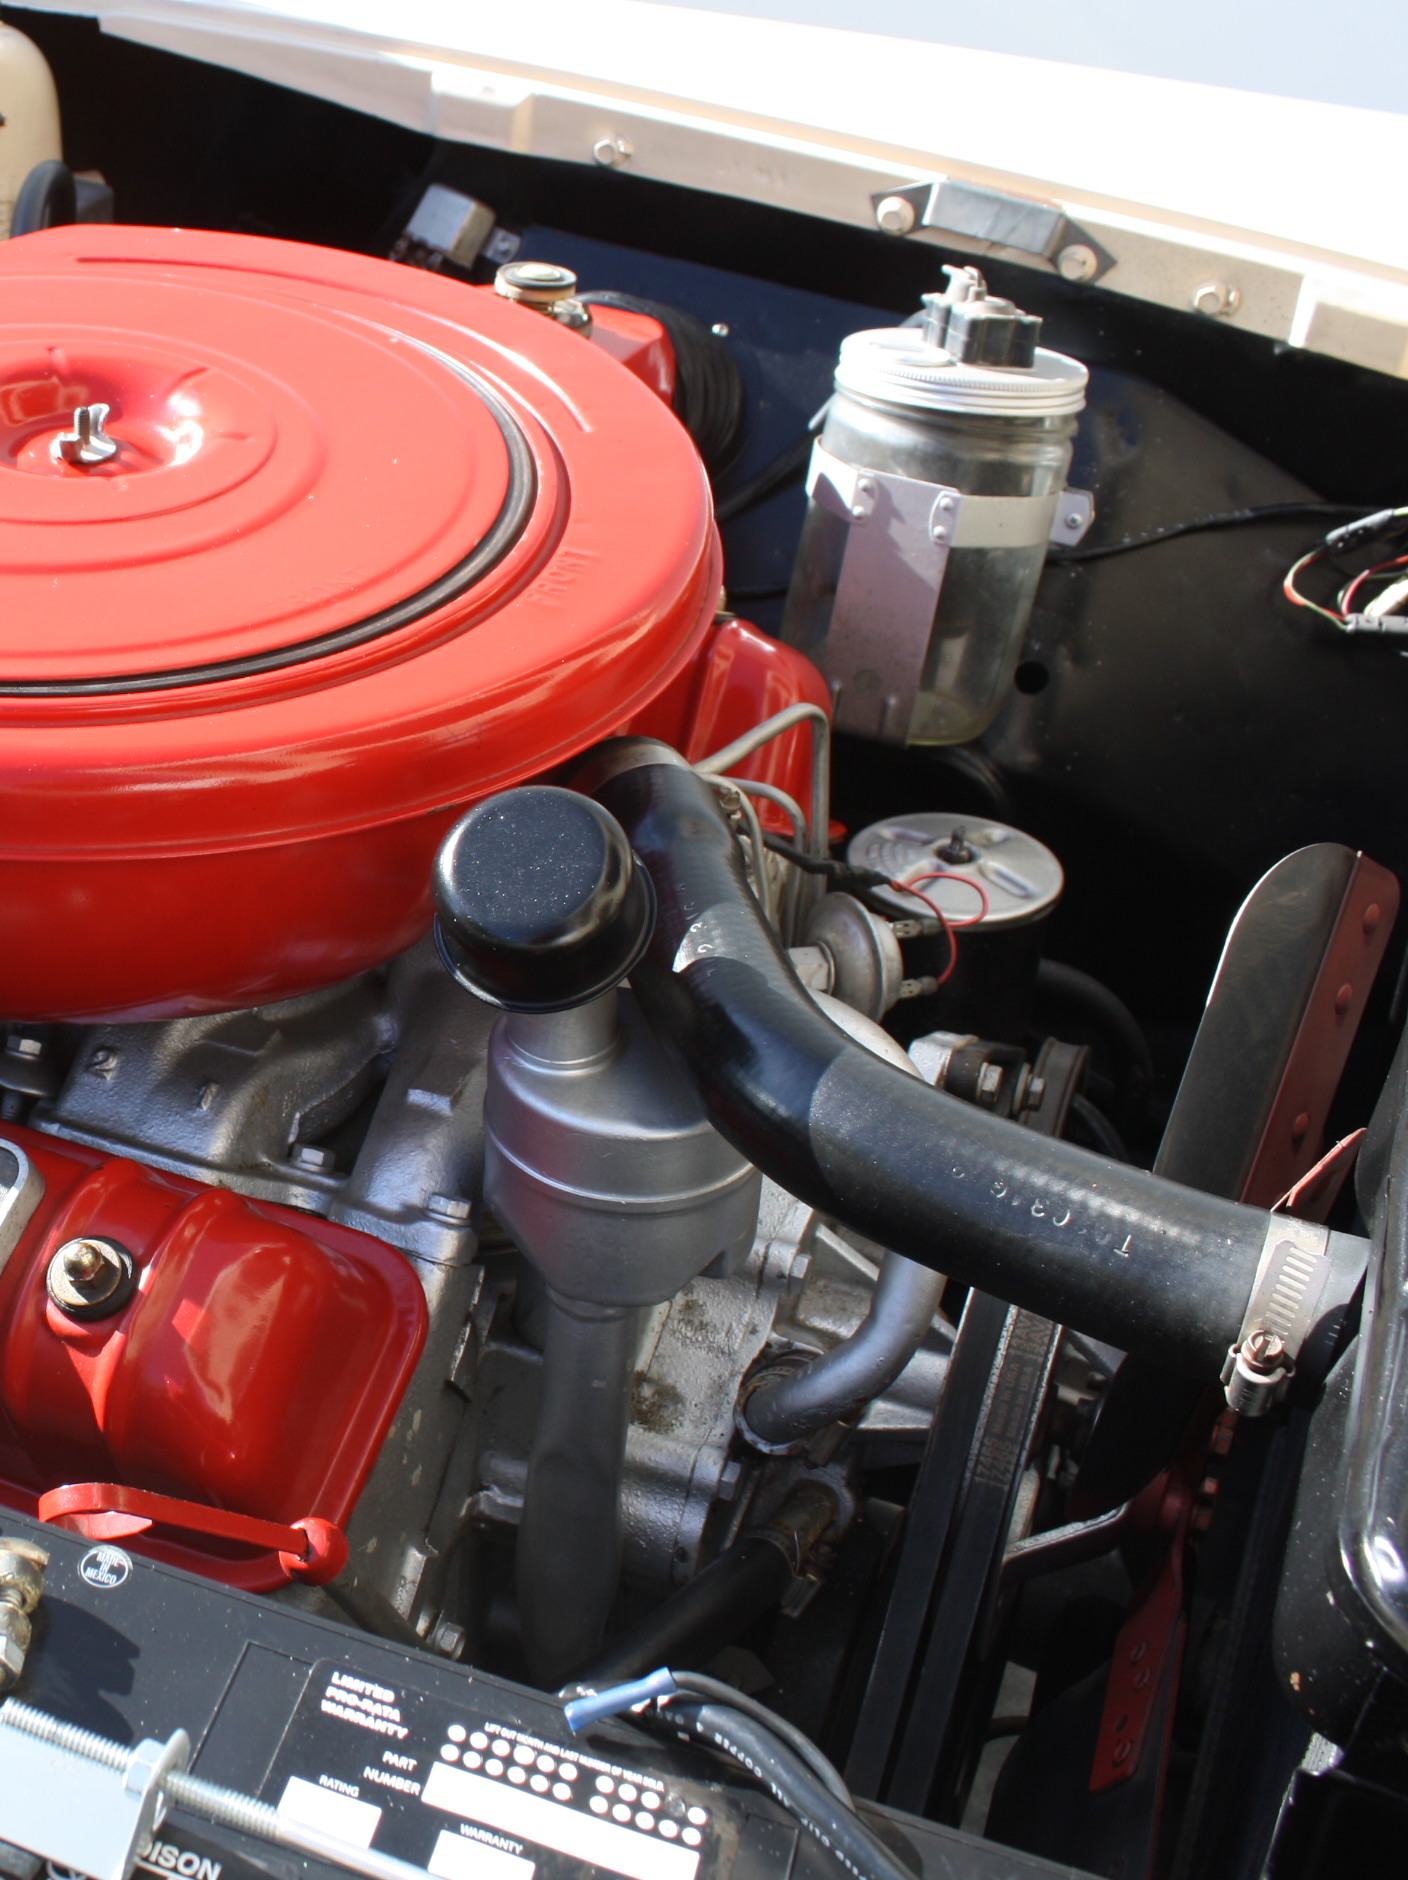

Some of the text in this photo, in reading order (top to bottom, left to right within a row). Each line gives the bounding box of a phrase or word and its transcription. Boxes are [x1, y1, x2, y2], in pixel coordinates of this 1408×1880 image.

[84, 1566, 118, 1585] MEXICO
[96, 1551, 120, 1568] MADE
[331, 1671, 396, 1704] LIMITED
[320, 1698, 409, 1740] WARRANTY
[325, 1685, 401, 1723] PRO-RATA
[382, 1750, 418, 1772] PART
[484, 1722, 502, 1735] LIFT
[500, 1727, 517, 1740] OUT
[516, 1733, 544, 1750] MONTH
[543, 1742, 561, 1756] AND
[560, 1748, 580, 1763] LAST
[579, 1752, 612, 1774] NUMBER
[622, 1768, 643, 1785] YEAR
[714, 1732, 762, 1778] COPPER
[319, 1774, 360, 1799] RATING
[363, 1766, 422, 1796] NUMBER
[460, 1823, 523, 1855] WARRANTY
